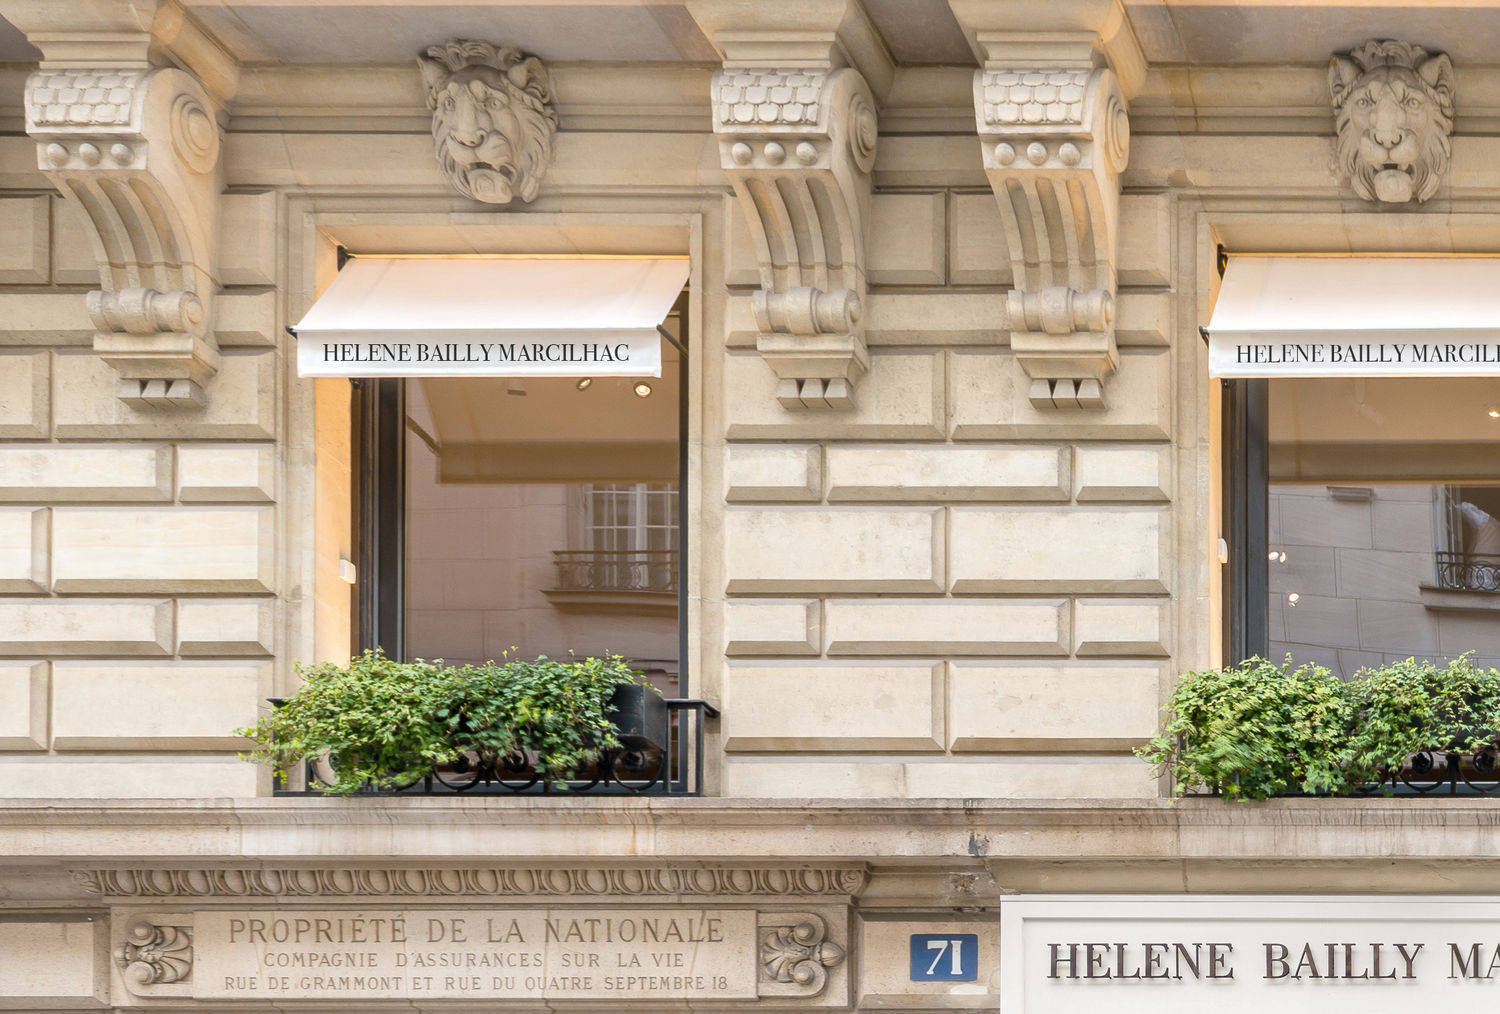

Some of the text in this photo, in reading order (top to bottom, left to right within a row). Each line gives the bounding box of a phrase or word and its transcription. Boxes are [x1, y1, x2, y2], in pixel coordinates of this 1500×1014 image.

[323, 343, 630, 362] HELENE BAILLY MARCILHAC
[1236, 344, 1325, 363] HELENE
[1330, 344, 1408, 363] BAILLY
[229, 913, 724, 943] PROPRIÉTÉ DE LA NATIONALE
[263, 952, 684, 967] COMPAGNIE D'ASSURANCES SUR LA VIE
[926, 940, 963, 975] 71
[1047, 942, 1235, 981] HELENE
[1262, 942, 1424, 981] BAILLY
[224, 976, 728, 992] RUE DE GRAMMONT ET RUE DU QUATRE SEPTEMBRE 18
